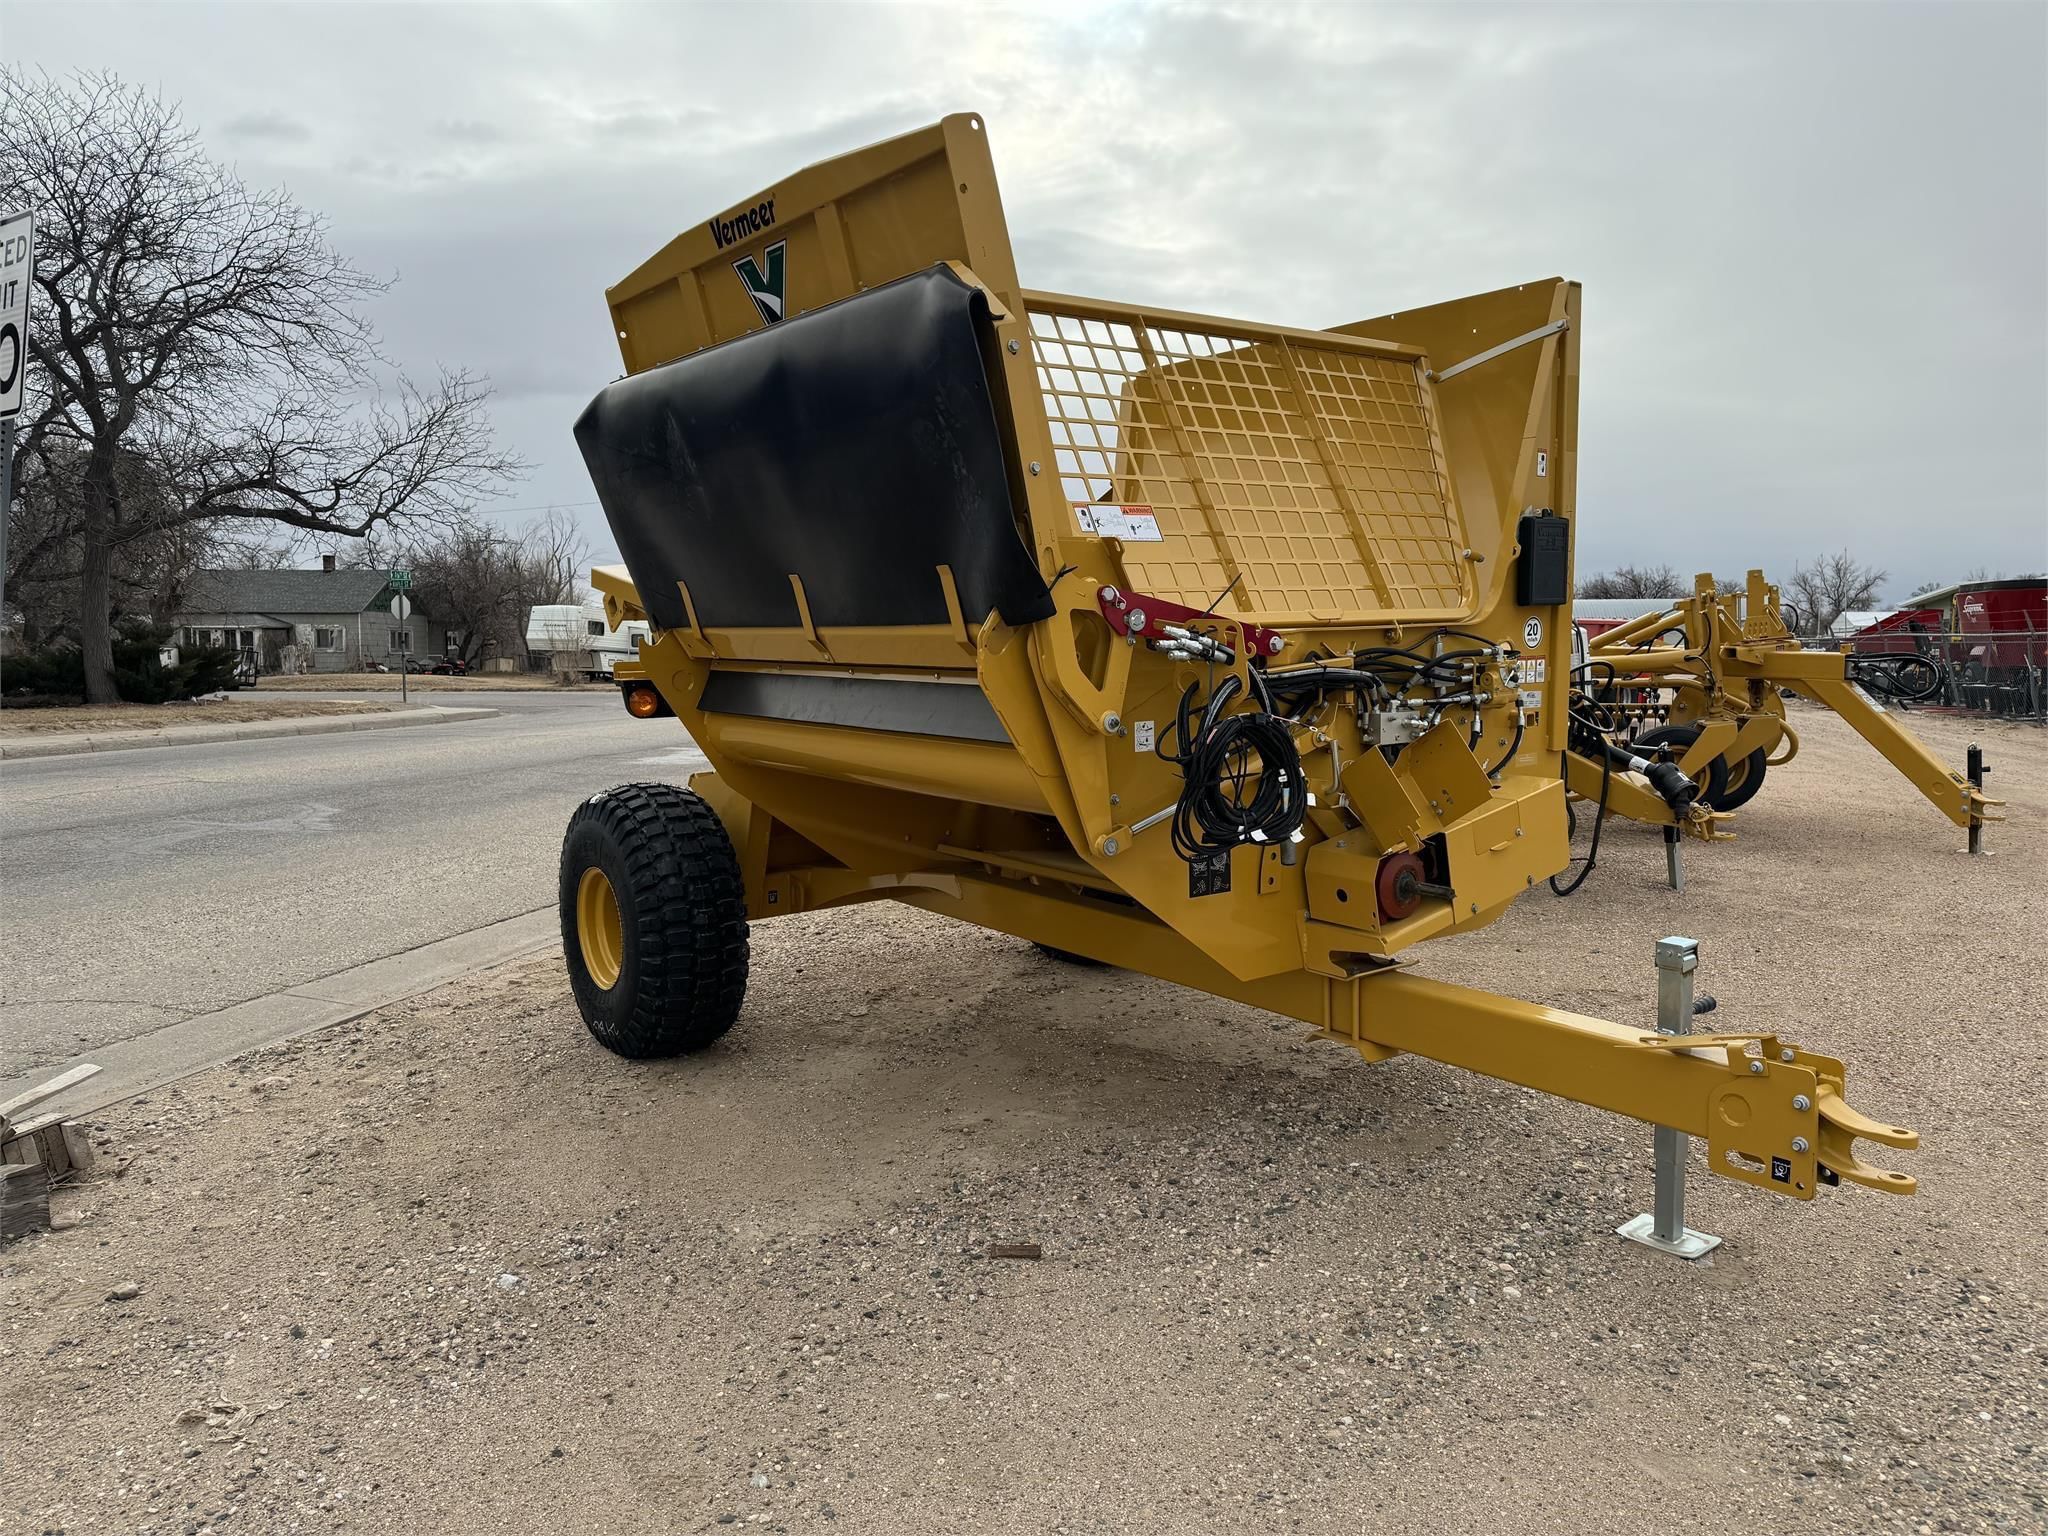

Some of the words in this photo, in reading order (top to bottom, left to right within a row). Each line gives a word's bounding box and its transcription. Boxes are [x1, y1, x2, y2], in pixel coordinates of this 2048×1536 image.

[709, 199, 776, 249] Vermeer
[0, 235, 27, 268] ED
[0, 279, 18, 310] IT
[1527, 623, 1539, 637] 20
